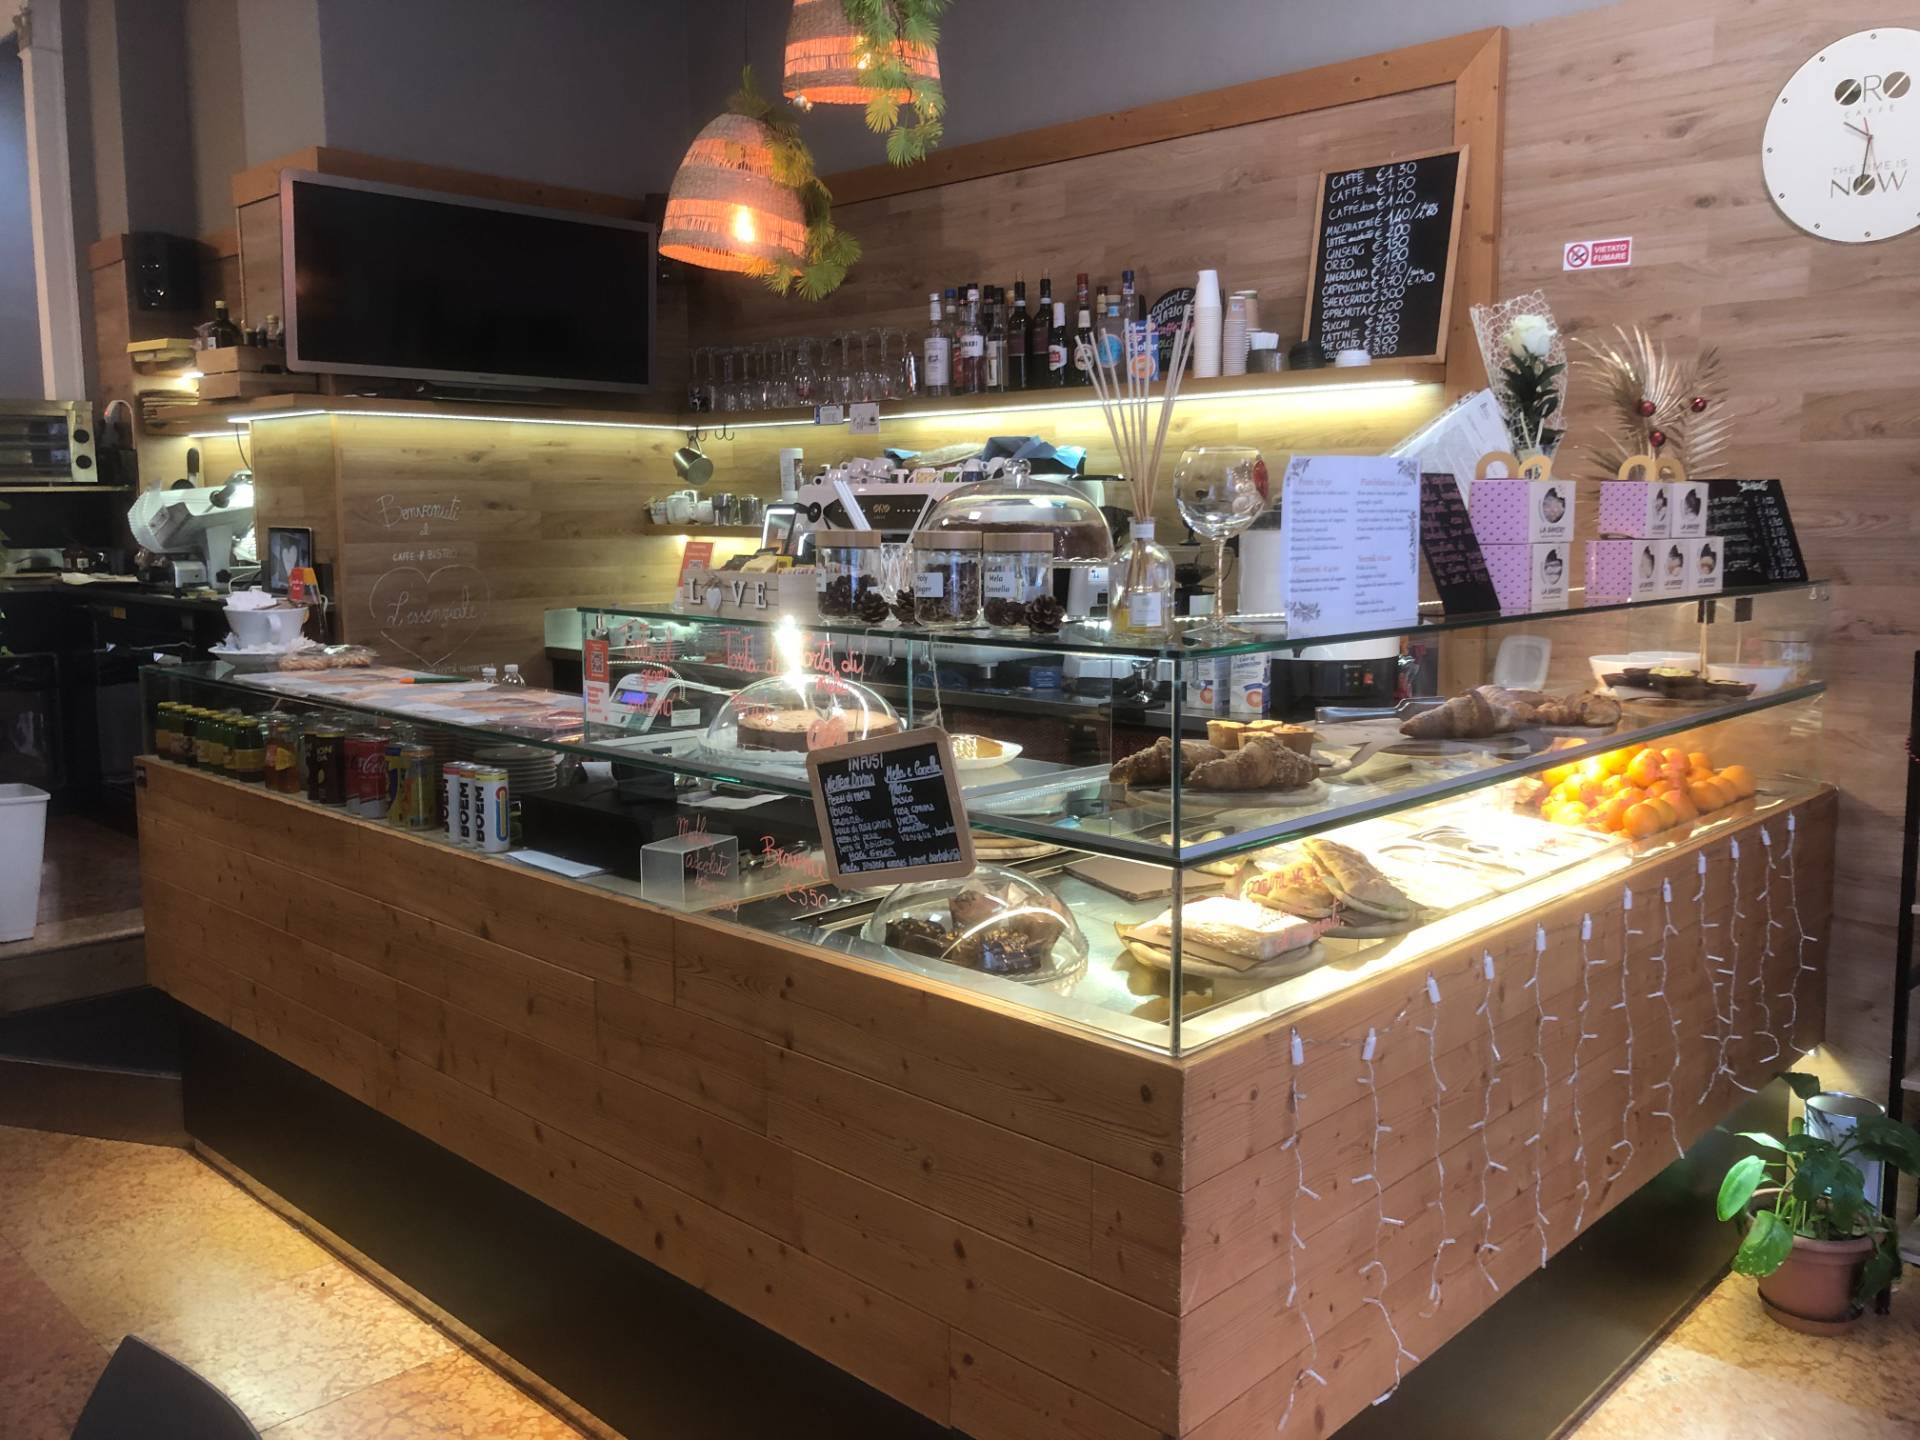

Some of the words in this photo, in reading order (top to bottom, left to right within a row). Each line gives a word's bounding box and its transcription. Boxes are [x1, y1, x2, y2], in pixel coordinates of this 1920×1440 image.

[1830, 170, 1908, 199] NOW
[1593, 243, 1627, 253] VIETATO
[1593, 252, 1627, 262] FUMARE
[1324, 258, 1355, 272] ORZO
[1324, 268, 1368, 284] AMERICANO
[1321, 328, 1359, 343] LATTINE
[375, 494, 461, 528] Benvenuti
[848, 752, 884, 772] INFUSI
[460, 782, 470, 838] BOEM
[475, 786, 485, 842] BOEM
